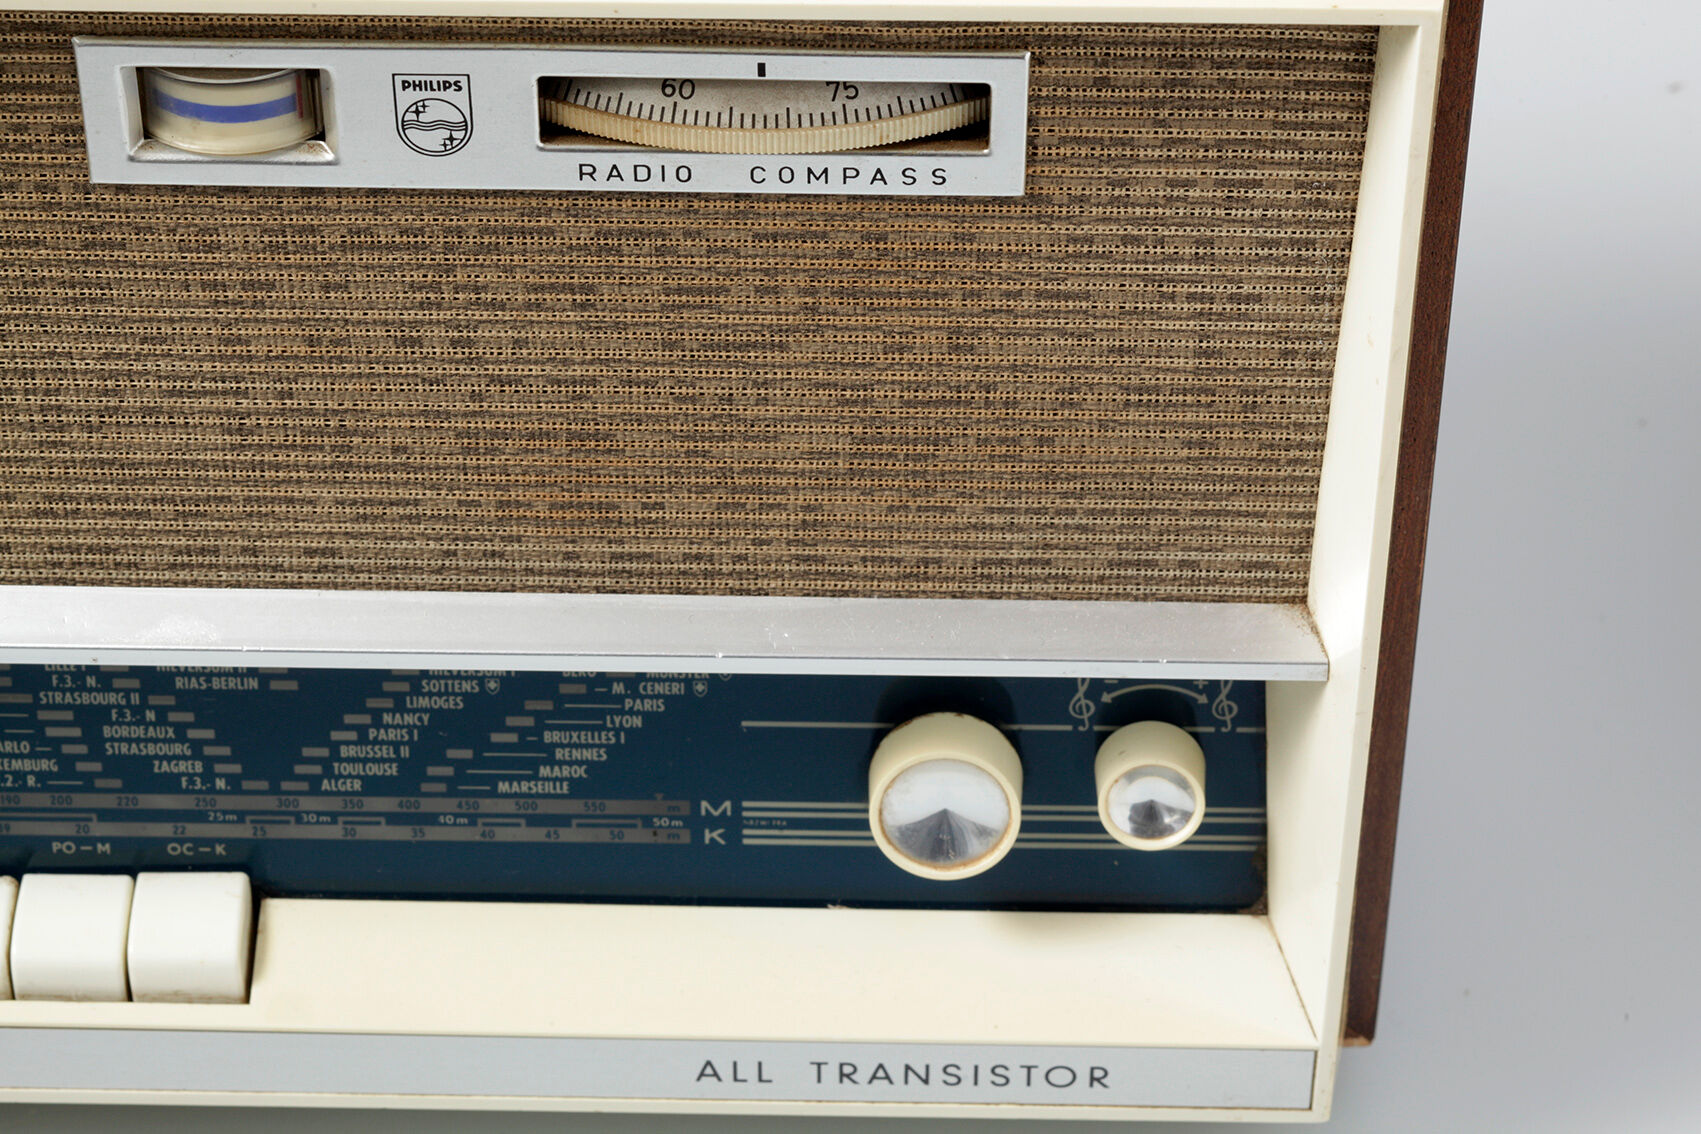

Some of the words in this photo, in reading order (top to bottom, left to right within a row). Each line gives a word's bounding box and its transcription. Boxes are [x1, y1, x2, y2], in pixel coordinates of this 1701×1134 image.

[401, 80, 462, 91] PHILIPS
[661, 78, 696, 100] 60
[826, 81, 859, 101] 75
[578, 163, 692, 182] RADIO
[750, 166, 947, 185] COMPASS
[175, 677, 259, 690] RIAS-BERLIN
[422, 680, 479, 693] SOTTENS
[639, 682, 684, 694] CENERI
[40, 692, 126, 705] STRASBOURG
[406, 696, 464, 709] LIMOGES
[624, 699, 665, 711] PARIS
[383, 713, 430, 726] NANCY
[606, 716, 642, 728] LYON
[103, 726, 176, 739] BORDEAUX
[369, 728, 409, 741] PARIS
[544, 731, 615, 744] BRUXELLES
[105, 743, 191, 755] STRASBOURG
[340, 745, 396, 758] BRUSSEL
[555, 748, 607, 761] RENNES
[153, 760, 203, 773] ZAGREB
[333, 763, 398, 775] TOULOUSE
[539, 765, 588, 778] MAROC
[321, 779, 362, 791] ALGER
[498, 781, 570, 794] MARSEILLE
[51, 795, 73, 805] 200
[117, 796, 139, 807] 220
[194, 797, 217, 808] 250
[277, 798, 299, 808] 300
[342, 799, 364, 809] 350
[398, 800, 421, 810] 400
[457, 800, 479, 810] 450
[515, 801, 538, 811] 500
[584, 801, 606, 812] 550
[701, 800, 731, 816] M
[75, 824, 90, 834] 20
[173, 825, 186, 835] 22
[252, 826, 266, 837] 25
[342, 827, 357, 837] 30
[411, 828, 425, 838] 35
[480, 829, 495, 839] 40
[545, 830, 560, 840] 45
[609, 830, 624, 840] 50
[704, 828, 726, 845] K
[696, 1060, 772, 1083] ALL
[809, 1061, 1110, 1089] TRANSISTOR
